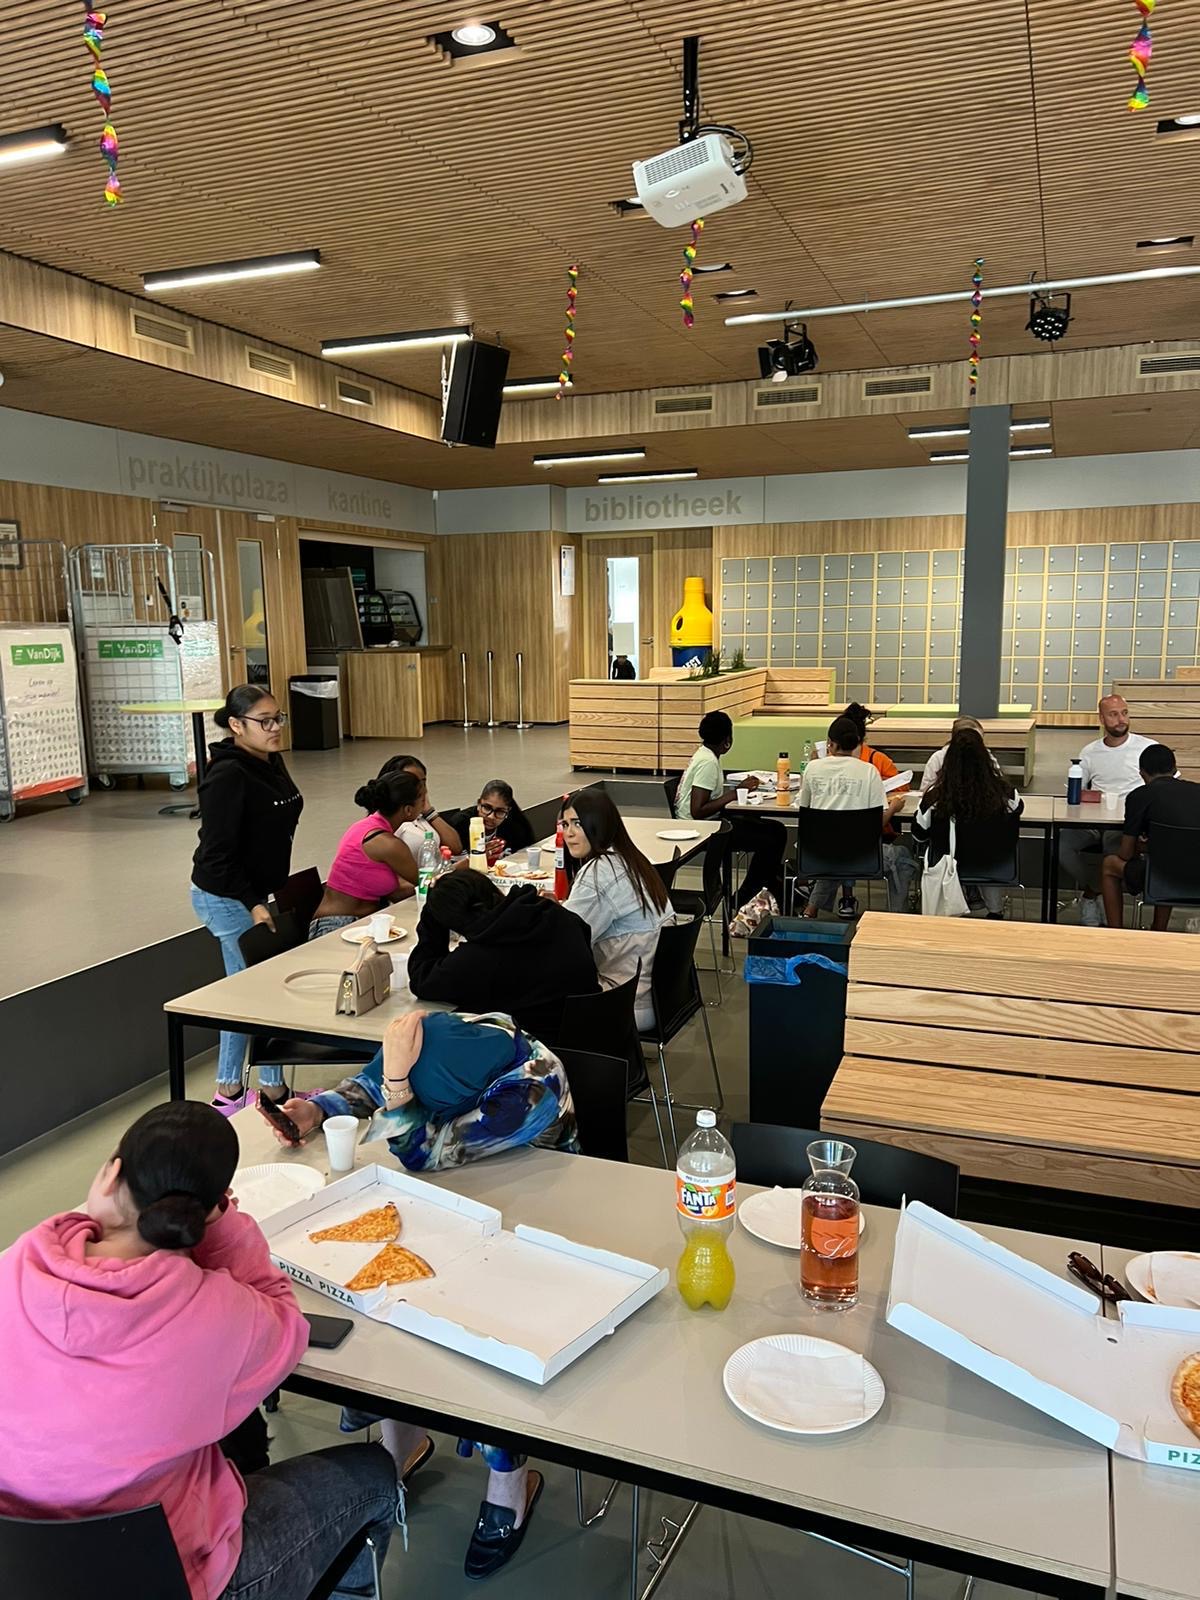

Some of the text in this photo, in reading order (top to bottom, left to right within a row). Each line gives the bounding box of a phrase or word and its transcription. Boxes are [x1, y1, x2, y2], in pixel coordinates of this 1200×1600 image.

[128, 455, 289, 504] praktijkplaza
[327, 484, 392, 518] kantine
[585, 489, 742, 522] bibliotheek
[27, 647, 61, 661] VanDijk
[116, 643, 160, 656] VanDijk
[681, 1187, 717, 1206] FANTA
[279, 1261, 355, 1306] PIZZA PIZZA
